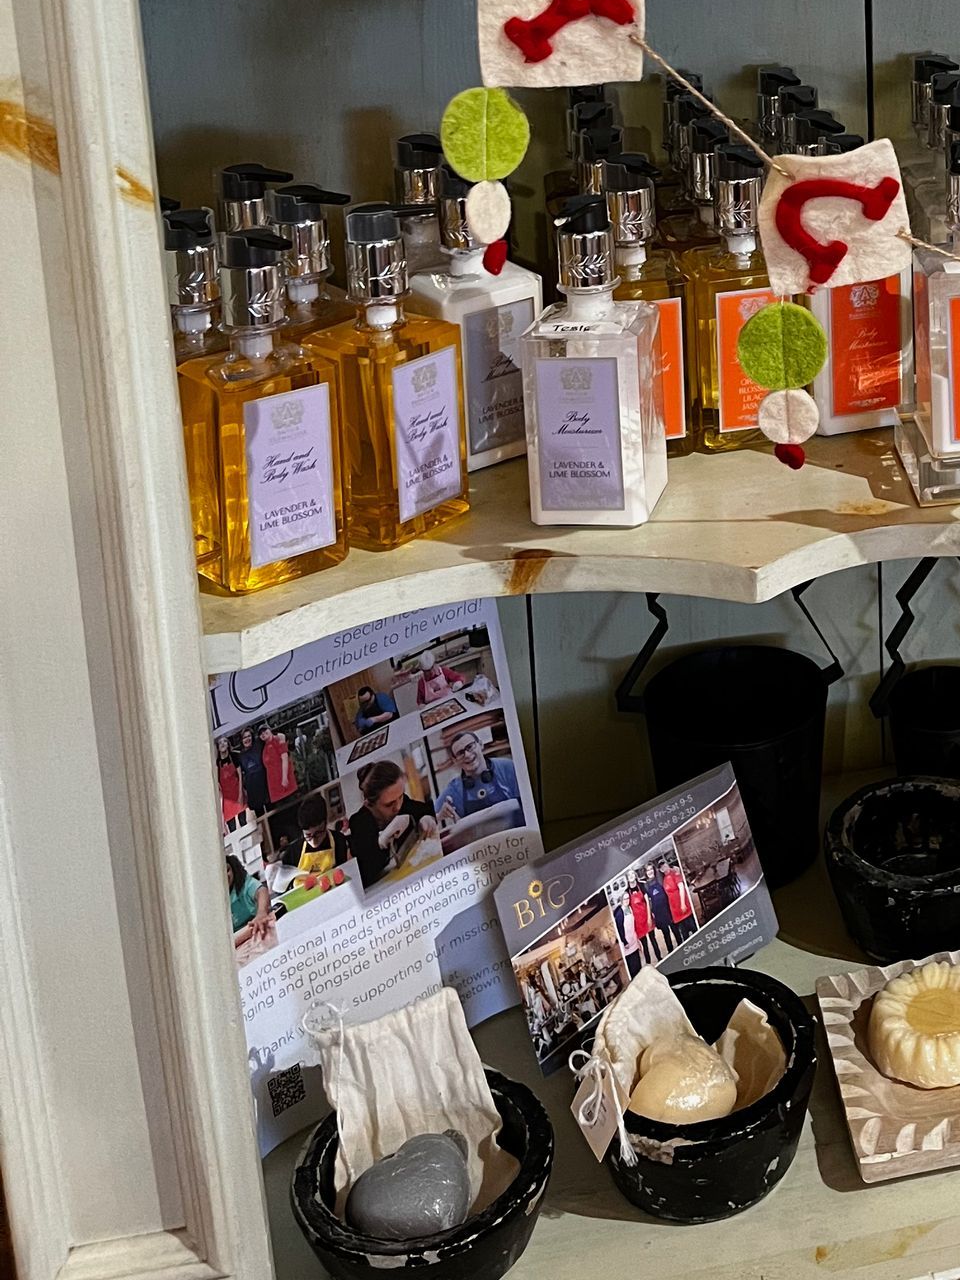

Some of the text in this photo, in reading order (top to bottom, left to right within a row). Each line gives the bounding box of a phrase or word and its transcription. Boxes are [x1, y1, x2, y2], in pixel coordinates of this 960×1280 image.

[562, 411, 591, 424] Body
[263, 447, 314, 468] Hand and
[409, 457, 442, 477] LAVENDER
[553, 461, 605, 469] LAVENDER &
[260, 459, 318, 484] Body Wash
[422, 461, 453, 480] BLOSSOM
[549, 471, 567, 479] LIME
[259, 506, 323, 532] LIME BLOSSOM
[264, 499, 316, 520] LAVENDER &
[293, 642, 377, 686] contribute
[384, 632, 399, 648] to
[404, 620, 428, 639] the
[432, 599, 483, 629] world!
[246, 835, 525, 986] a vocational and residential community for
[248, 977, 277, 1001] with
[280, 948, 329, 981] special
[332, 926, 374, 954] needs
[376, 910, 402, 932] that
[405, 877, 459, 913] provides
[462, 871, 470, 882] a
[473, 856, 512, 876] sense
[516, 849, 530, 861] of
[278, 977, 304, 998] and
[308, 948, 366, 987] purpose
[369, 915, 420, 950] through
[422, 872, 494, 919] meaningful
[705, 909, 756, 942] 512-943-8430
[303, 919, 441, 1001] alongside their peers
[352, 917, 500, 1007] supporting our mission
[256, 1032, 296, 1057] Thank
